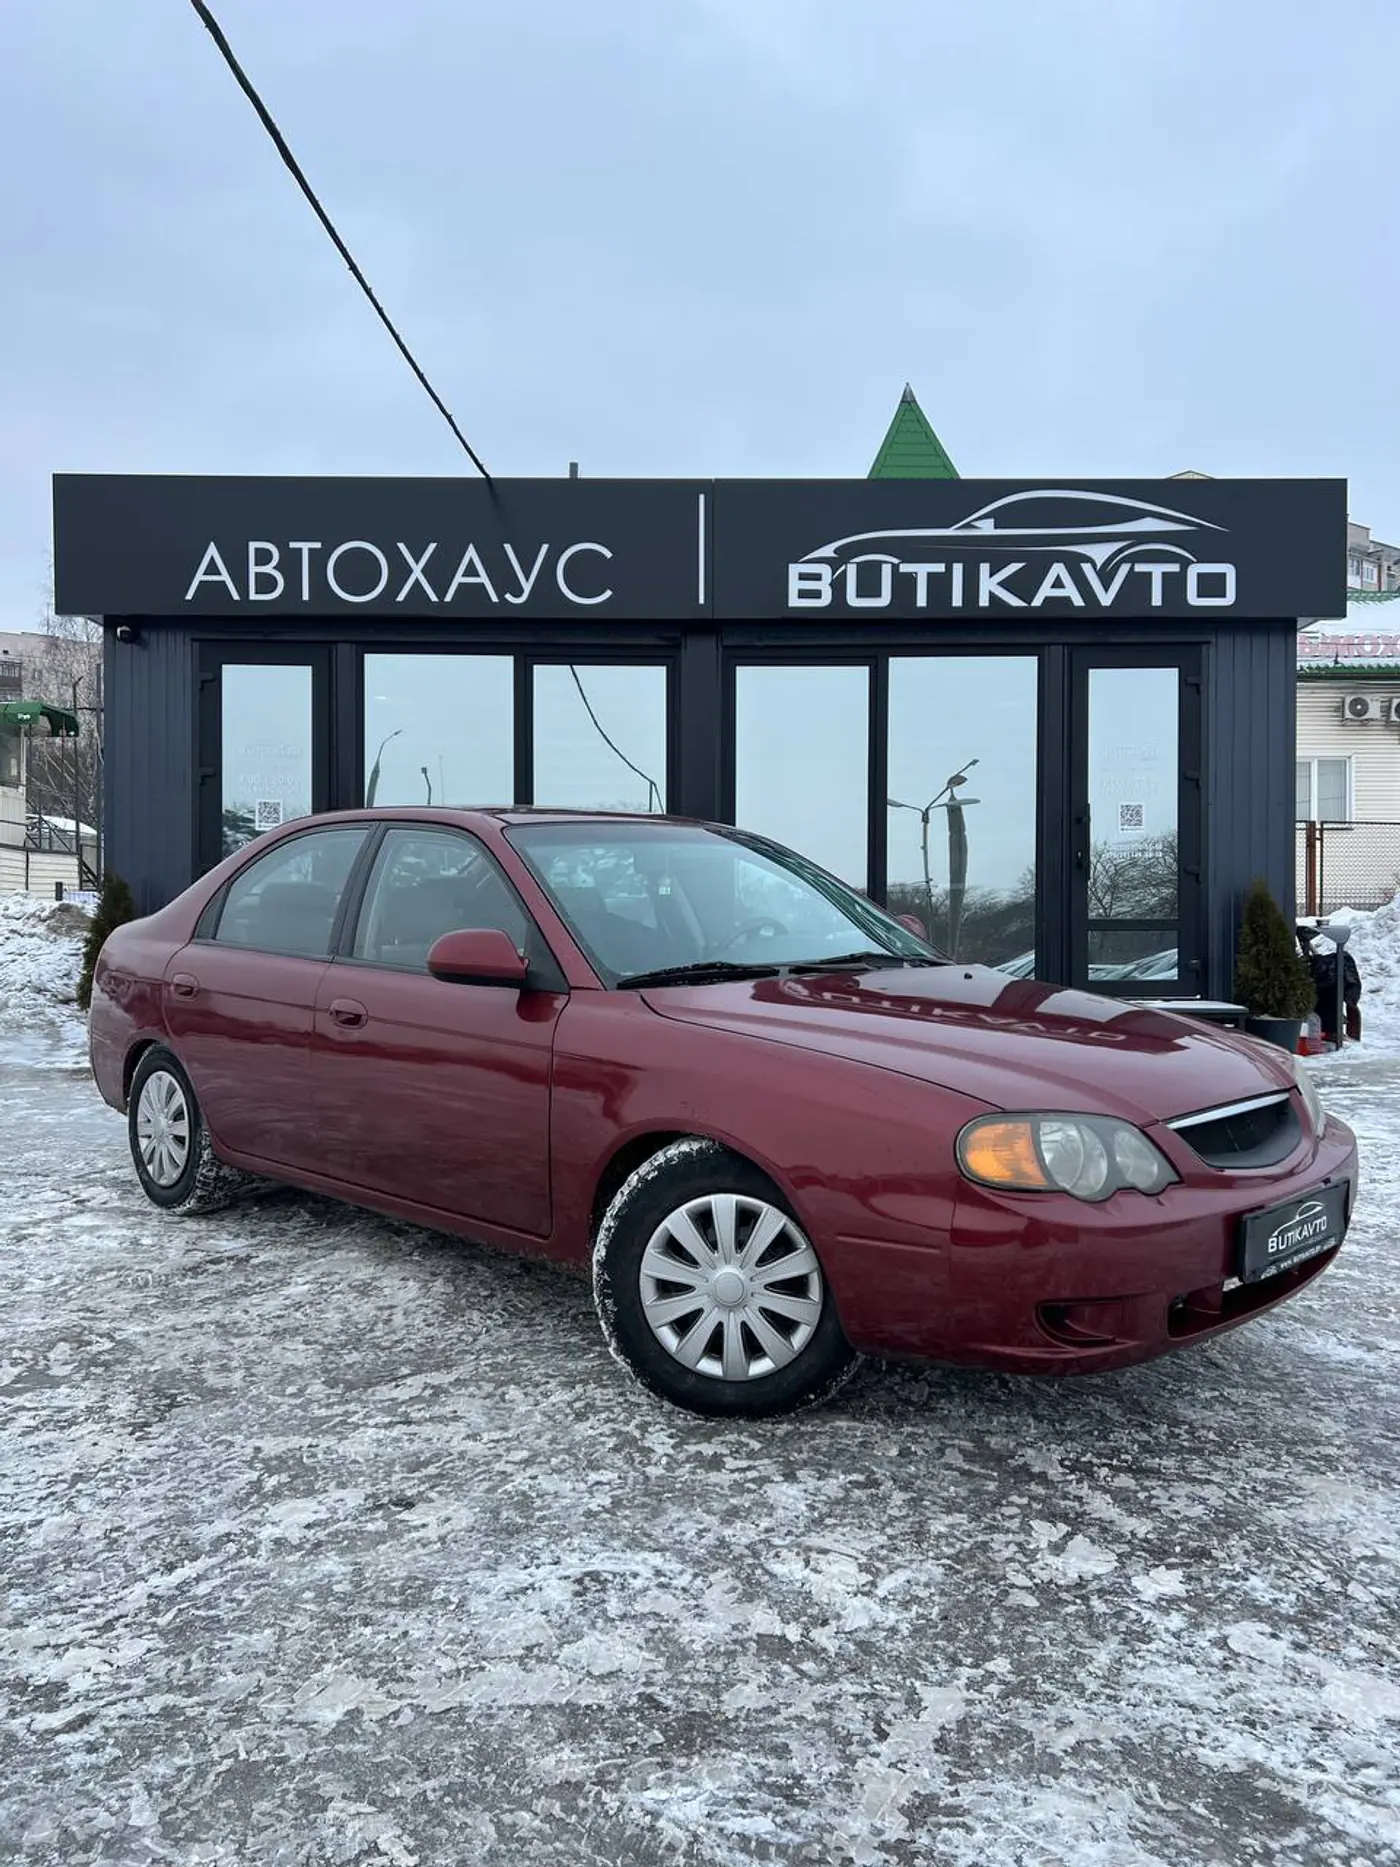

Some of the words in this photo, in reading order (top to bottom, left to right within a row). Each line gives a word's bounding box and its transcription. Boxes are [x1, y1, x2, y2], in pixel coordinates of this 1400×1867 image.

[185, 540, 613, 605] АВТОХАУС
[787, 561, 1238, 608] BUTIKAVTO
[1267, 1215, 1327, 1253] BUTIKAVTO
